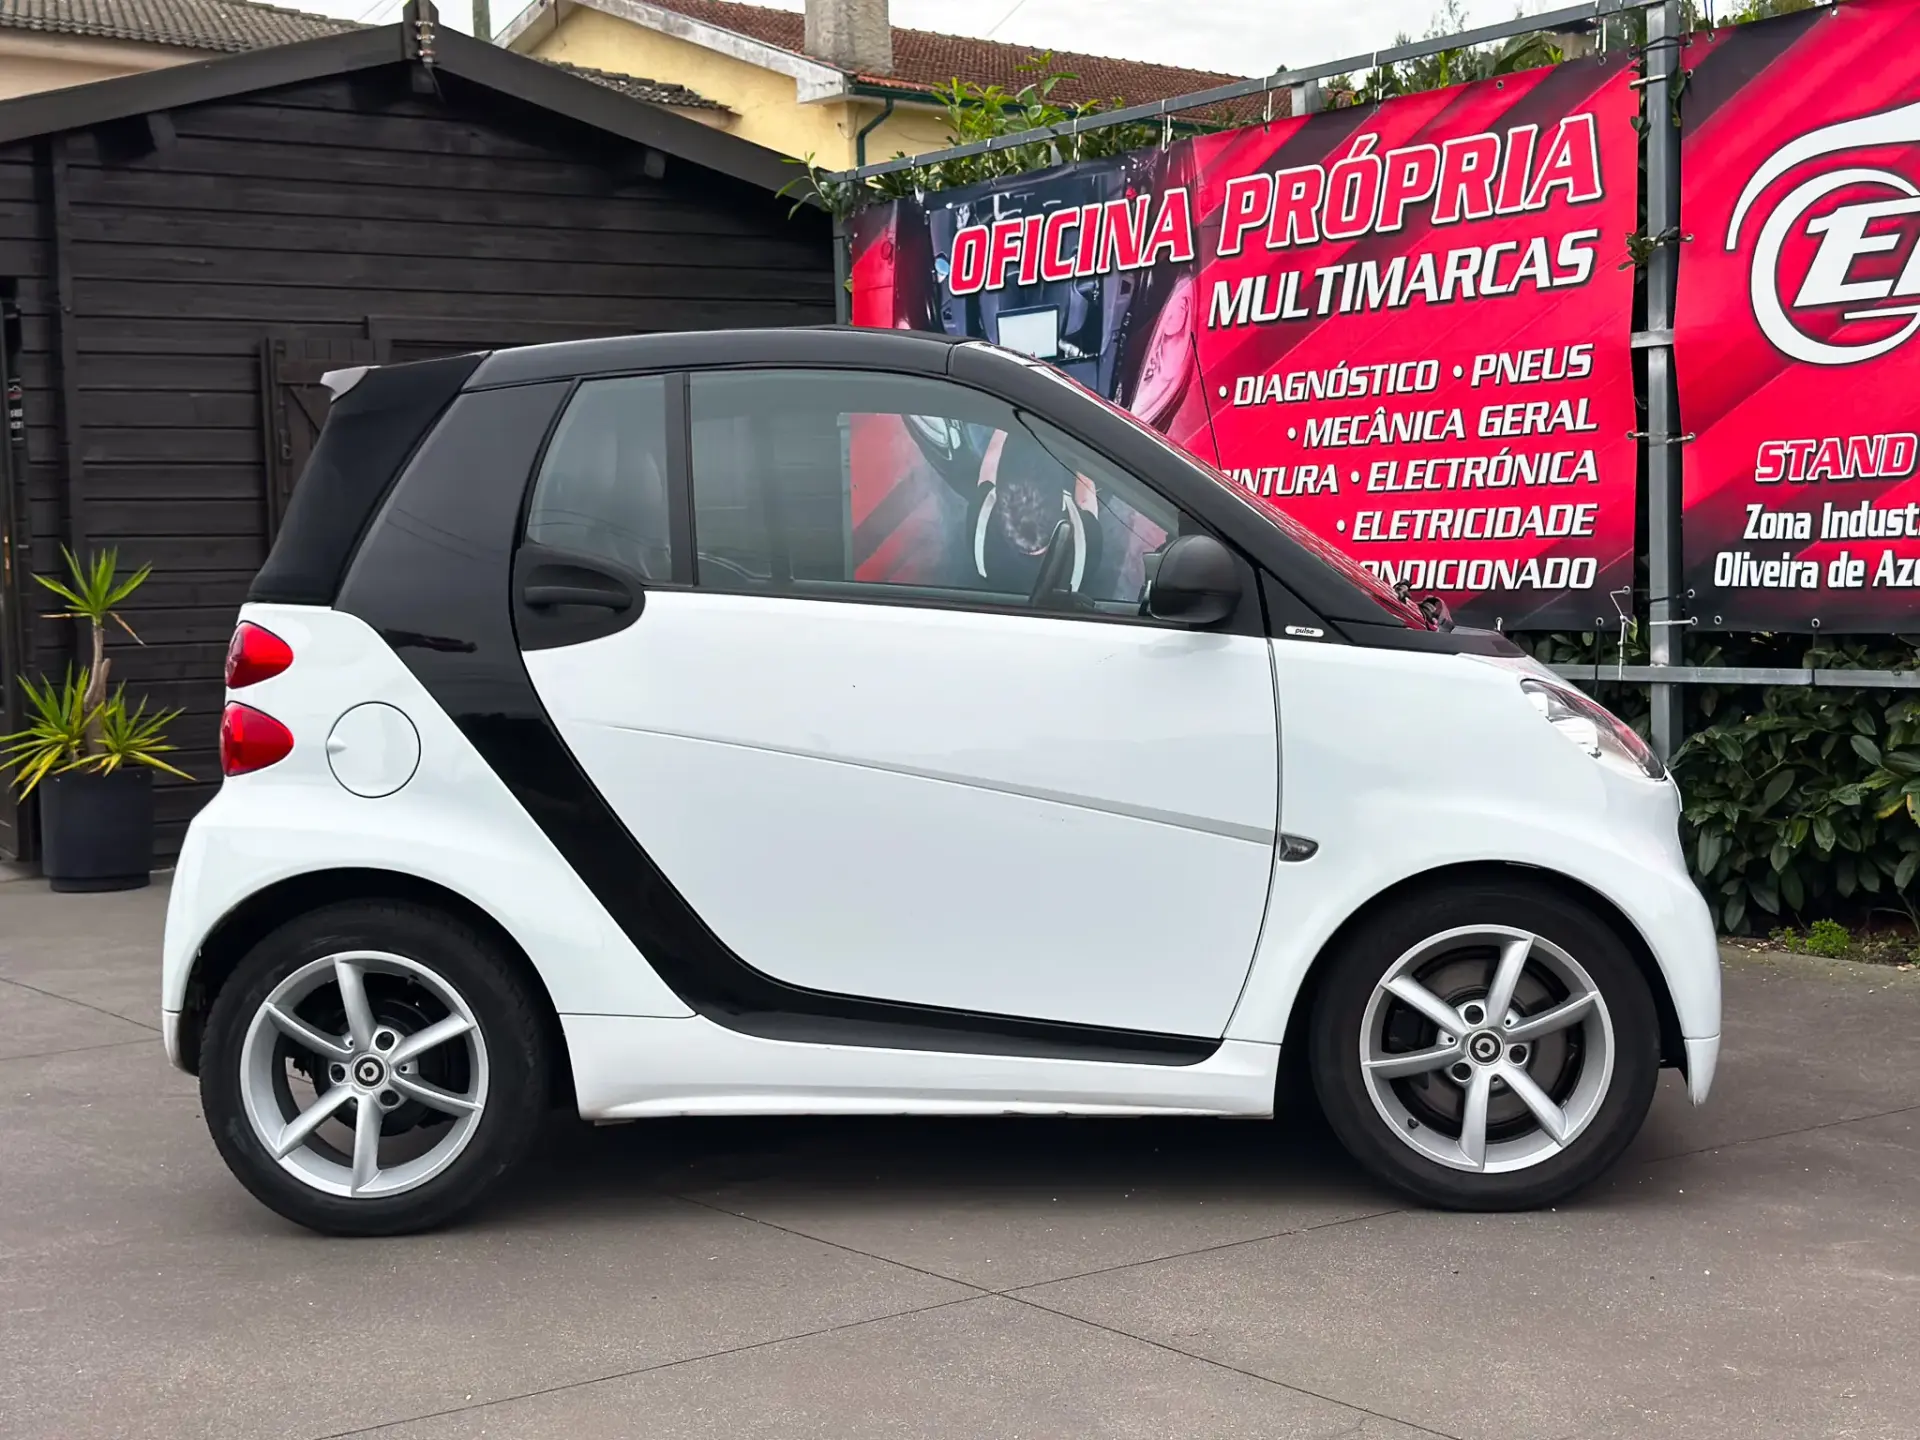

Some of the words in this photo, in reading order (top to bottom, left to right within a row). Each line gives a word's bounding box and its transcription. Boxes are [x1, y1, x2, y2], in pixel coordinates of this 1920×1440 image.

[949, 187, 1195, 296] OFICINA
[1216, 114, 1603, 257] PRÓPRIA
[1208, 229, 1598, 329] MULTIMARCAS
[1234, 359, 1438, 406] DIAGNÓSTICO
[1472, 344, 1594, 387] PNEUS
[1303, 407, 1465, 449] MECÂNICA
[1478, 398, 1597, 438] GERAL
[1366, 447, 1596, 490] ELECTRÓNICA
[1755, 433, 1917, 482] STAND
[1352, 504, 1597, 542] ELETRICIDADE
[1743, 503, 1812, 540] Zona
[1820, 501, 1920, 539] Indust
[1714, 552, 1819, 588] Oliveira
[1827, 551, 1865, 588] de
